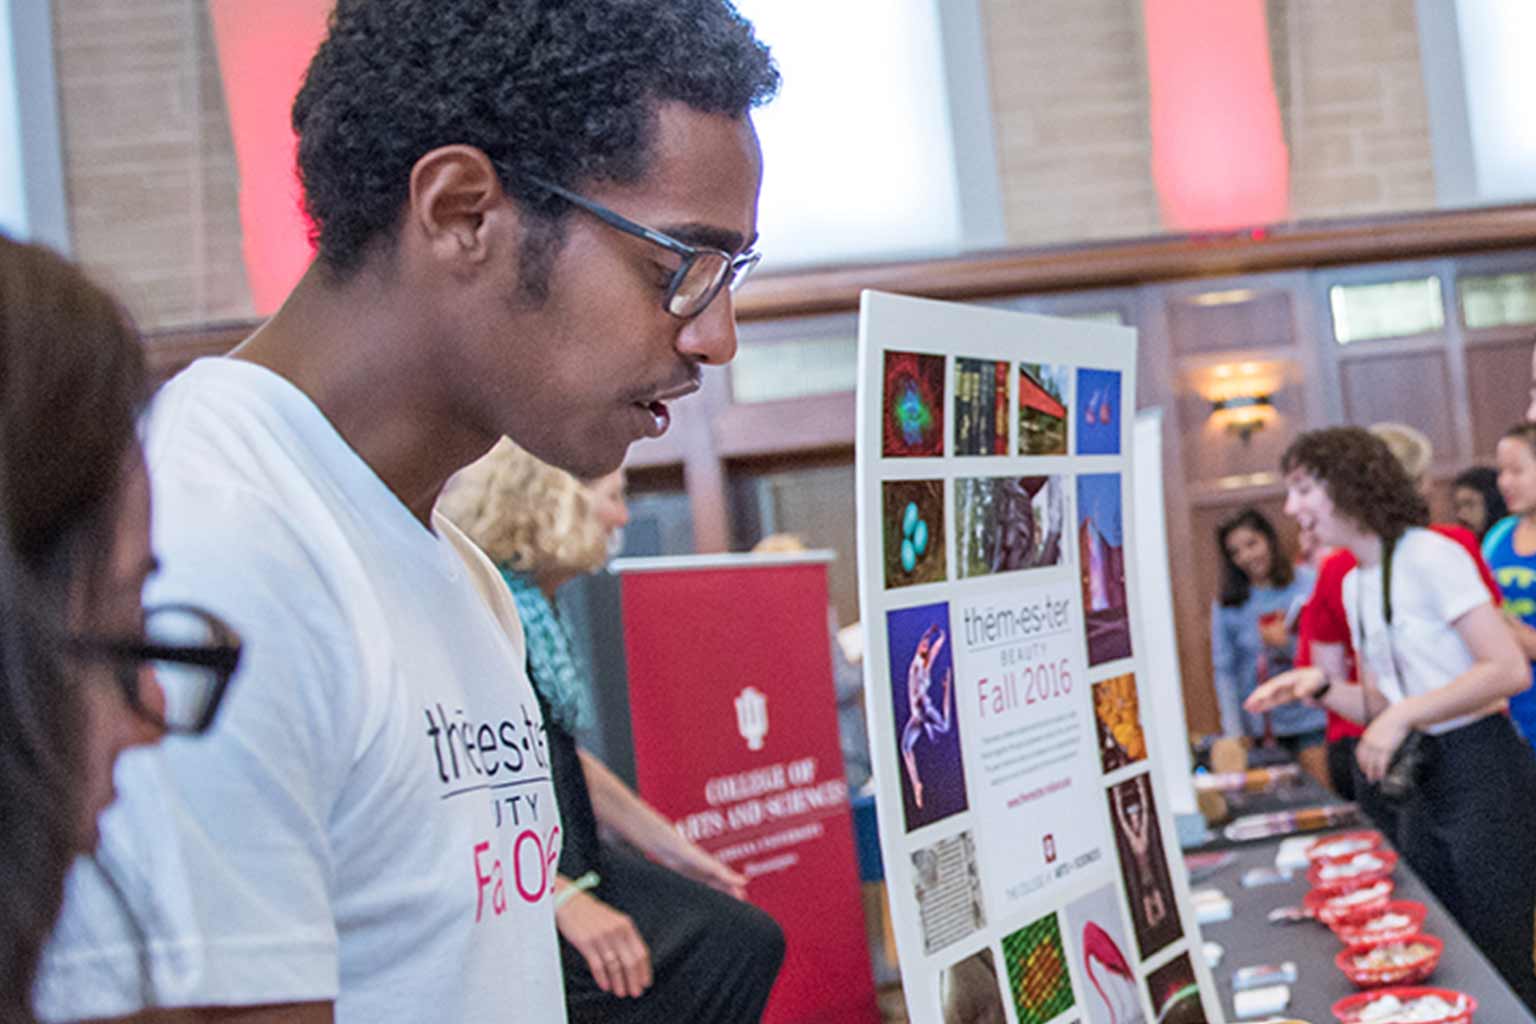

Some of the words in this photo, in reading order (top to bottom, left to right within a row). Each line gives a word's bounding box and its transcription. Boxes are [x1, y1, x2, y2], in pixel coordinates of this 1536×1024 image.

[978, 672, 1019, 719] Fall
[1024, 658, 1073, 704] 2016
[705, 764, 786, 806] COLLEGE
[788, 758, 815, 785] OF
[727, 801, 763, 830] AND
